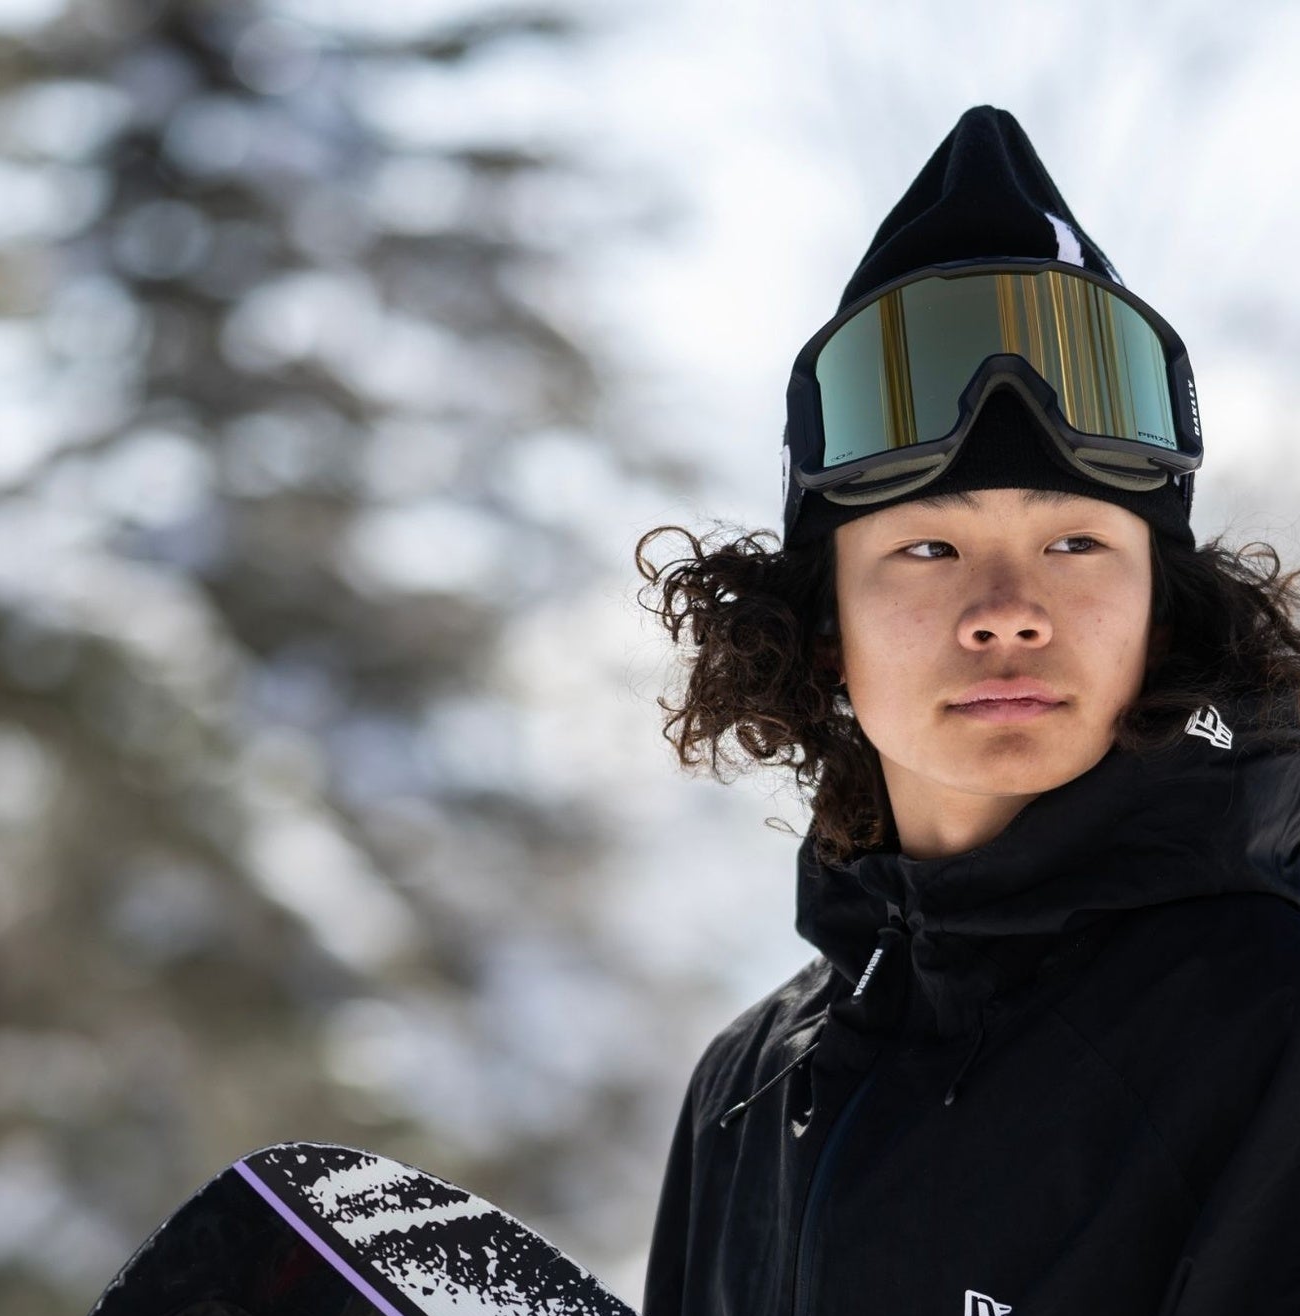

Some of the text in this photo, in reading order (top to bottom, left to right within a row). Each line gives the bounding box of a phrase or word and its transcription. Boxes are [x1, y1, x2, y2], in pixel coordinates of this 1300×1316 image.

[1187, 379, 1200, 437] OAKLEY
[852, 948, 883, 996] NEW ERA
